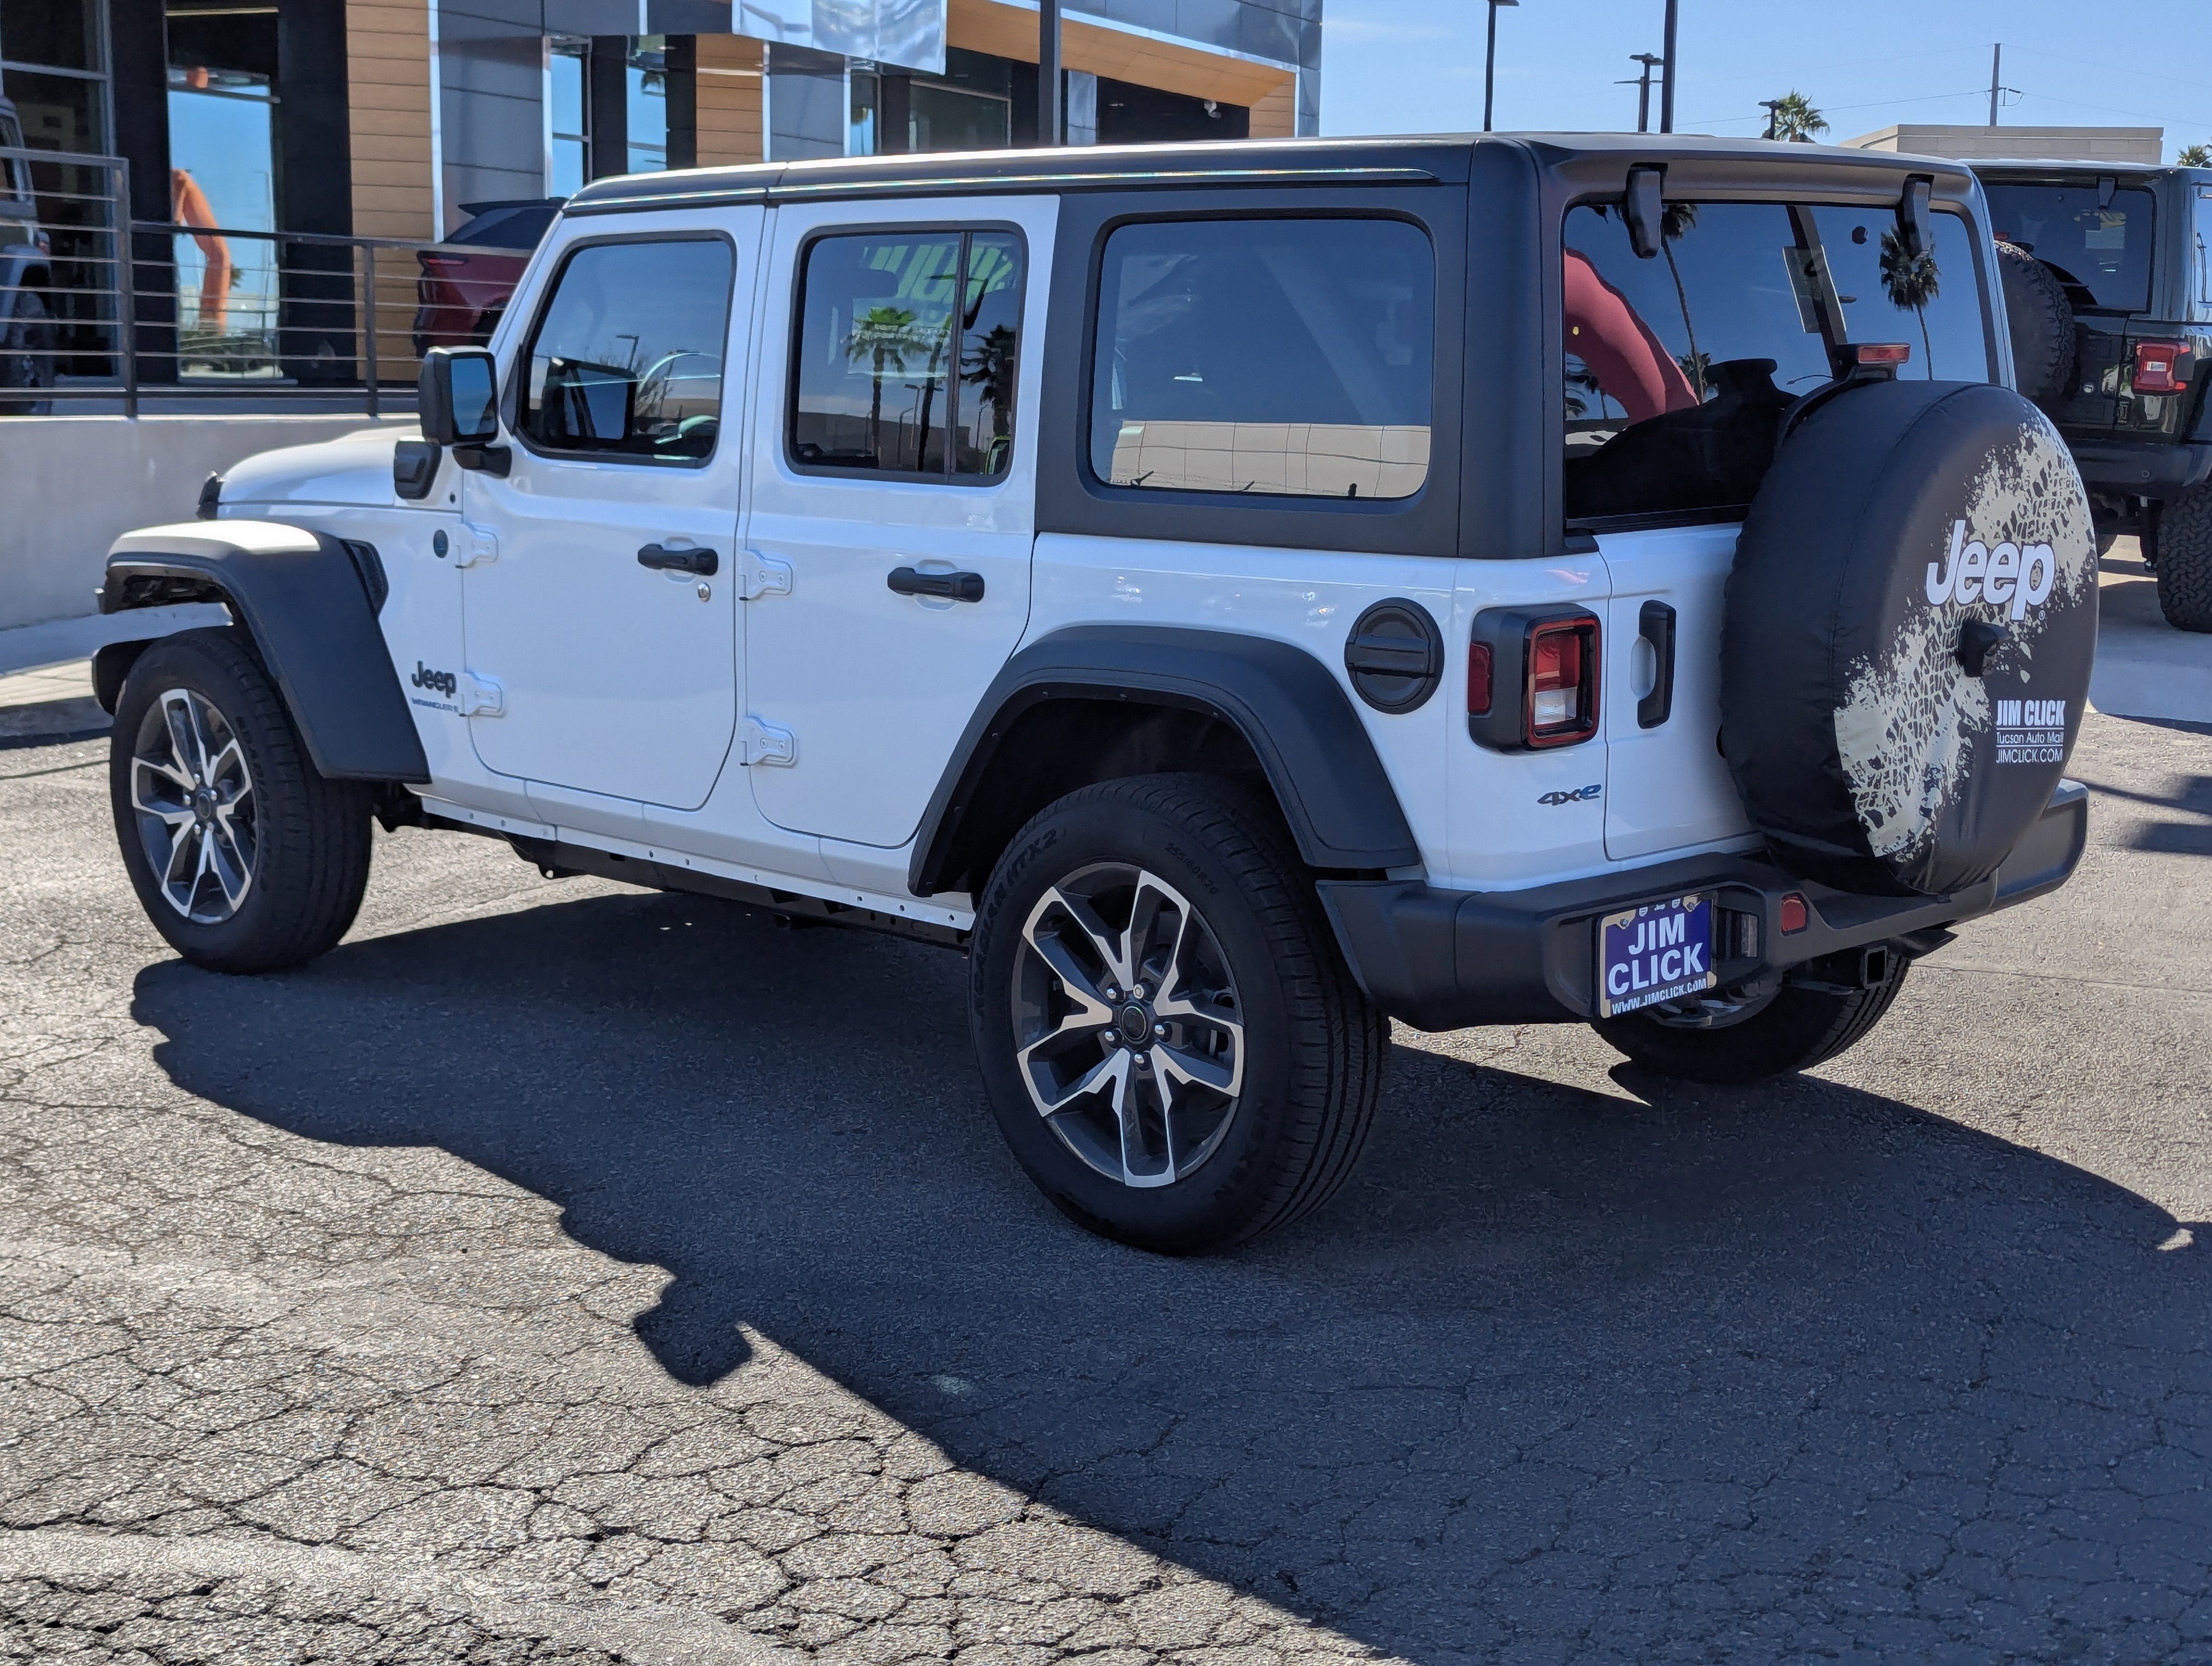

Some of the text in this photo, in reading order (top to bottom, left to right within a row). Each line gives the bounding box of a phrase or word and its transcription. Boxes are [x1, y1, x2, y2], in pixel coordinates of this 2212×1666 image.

[1926, 520, 2055, 621] Jeep
[411, 660, 457, 699] Jeep
[1996, 700, 2066, 726] JIM CLICK
[1996, 732, 2024, 744] Tucson
[2026, 732, 2045, 744] Auto
[1996, 748, 2063, 764] JIMCLICK.COM
[1536, 784, 1602, 806] 4xe
[1628, 913, 1685, 955] JIM
[1608, 942, 1704, 996] CLICK
[1612, 978, 1707, 1015] WWW.JIMCLICK.COM
